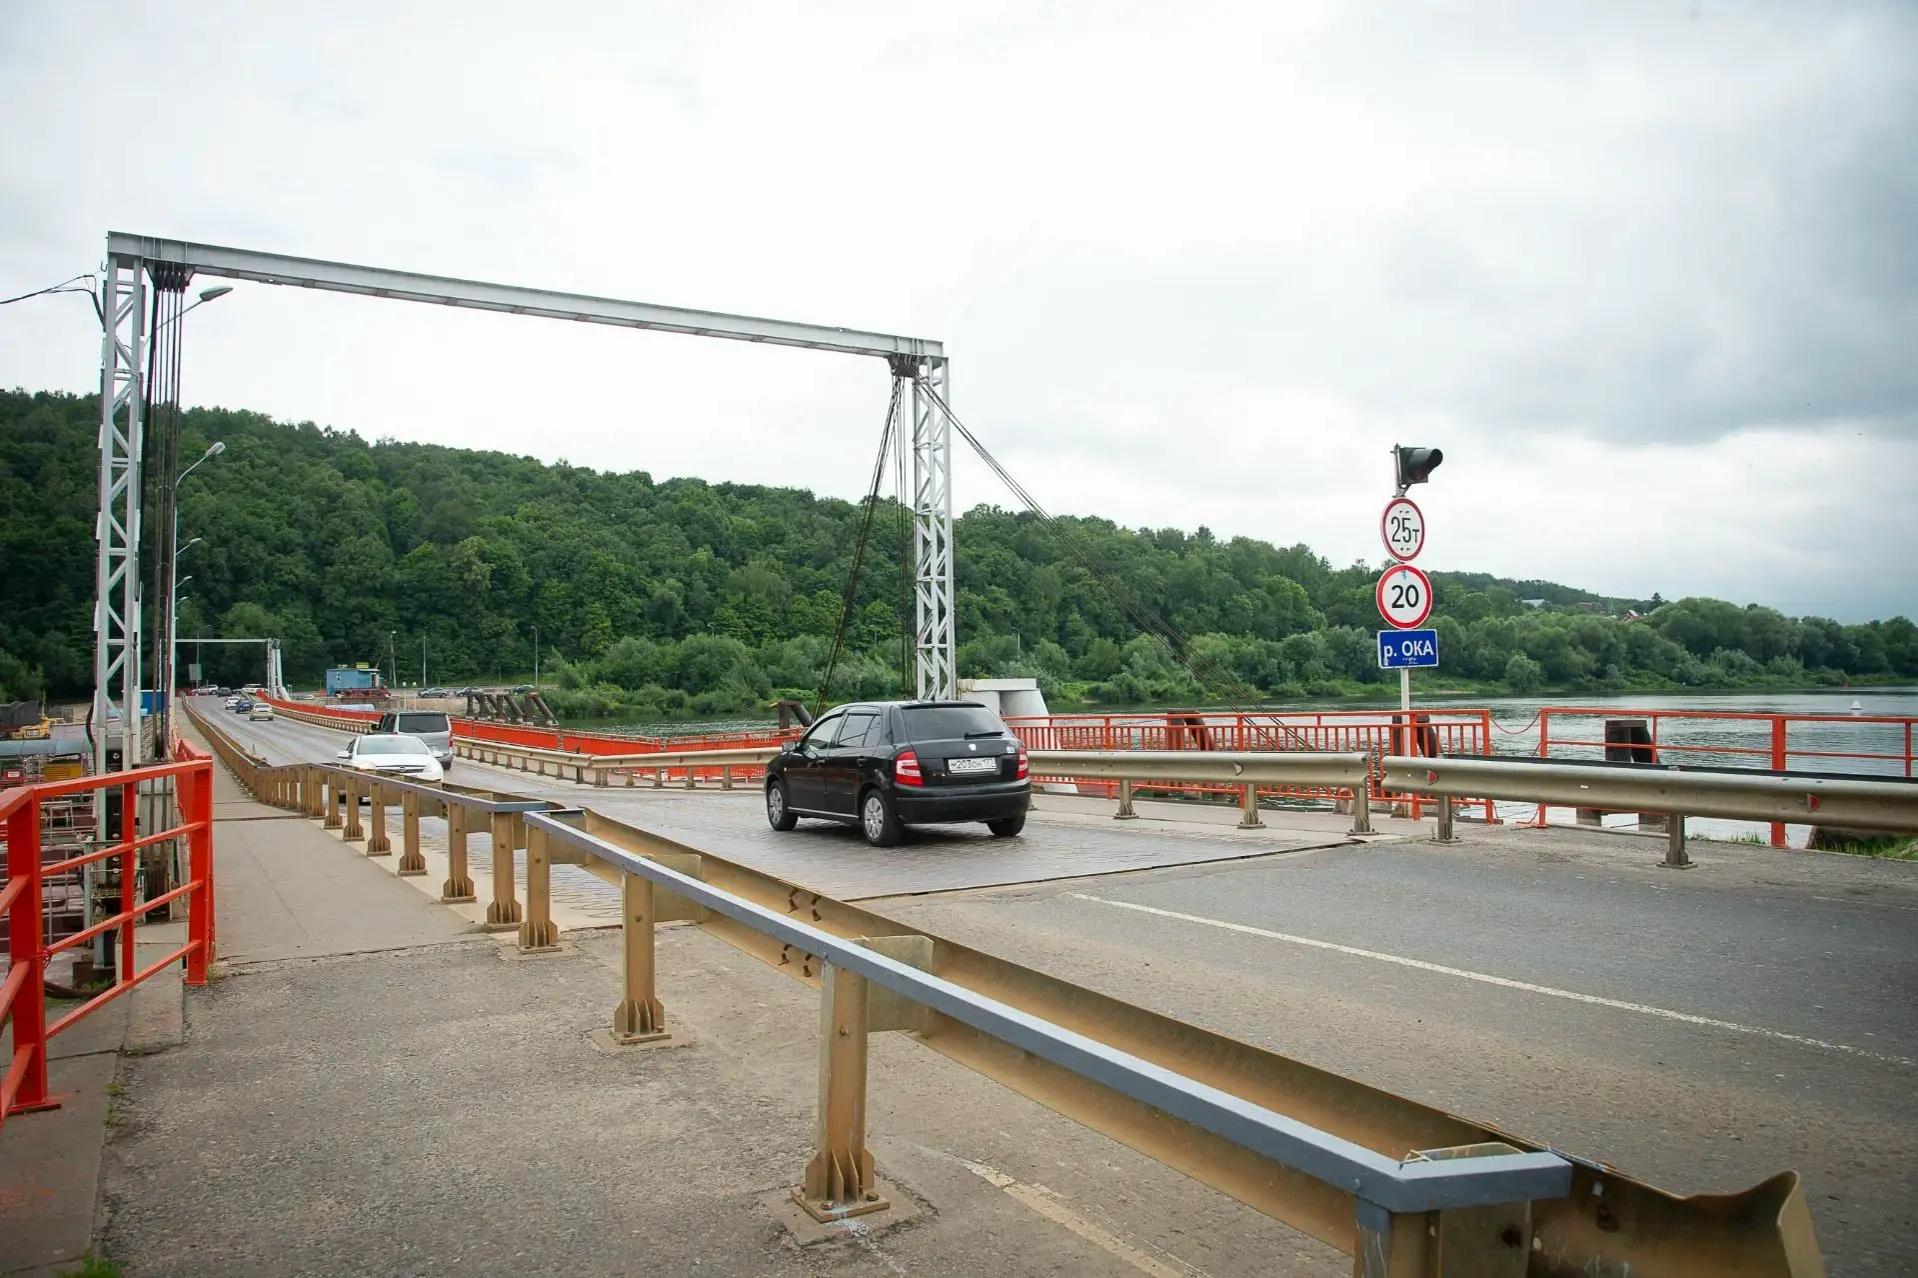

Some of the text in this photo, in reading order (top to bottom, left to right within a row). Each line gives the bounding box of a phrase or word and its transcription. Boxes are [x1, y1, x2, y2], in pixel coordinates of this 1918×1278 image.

[1391, 584, 1419, 609] 20
[1383, 640, 1434, 662] р. ОКА
